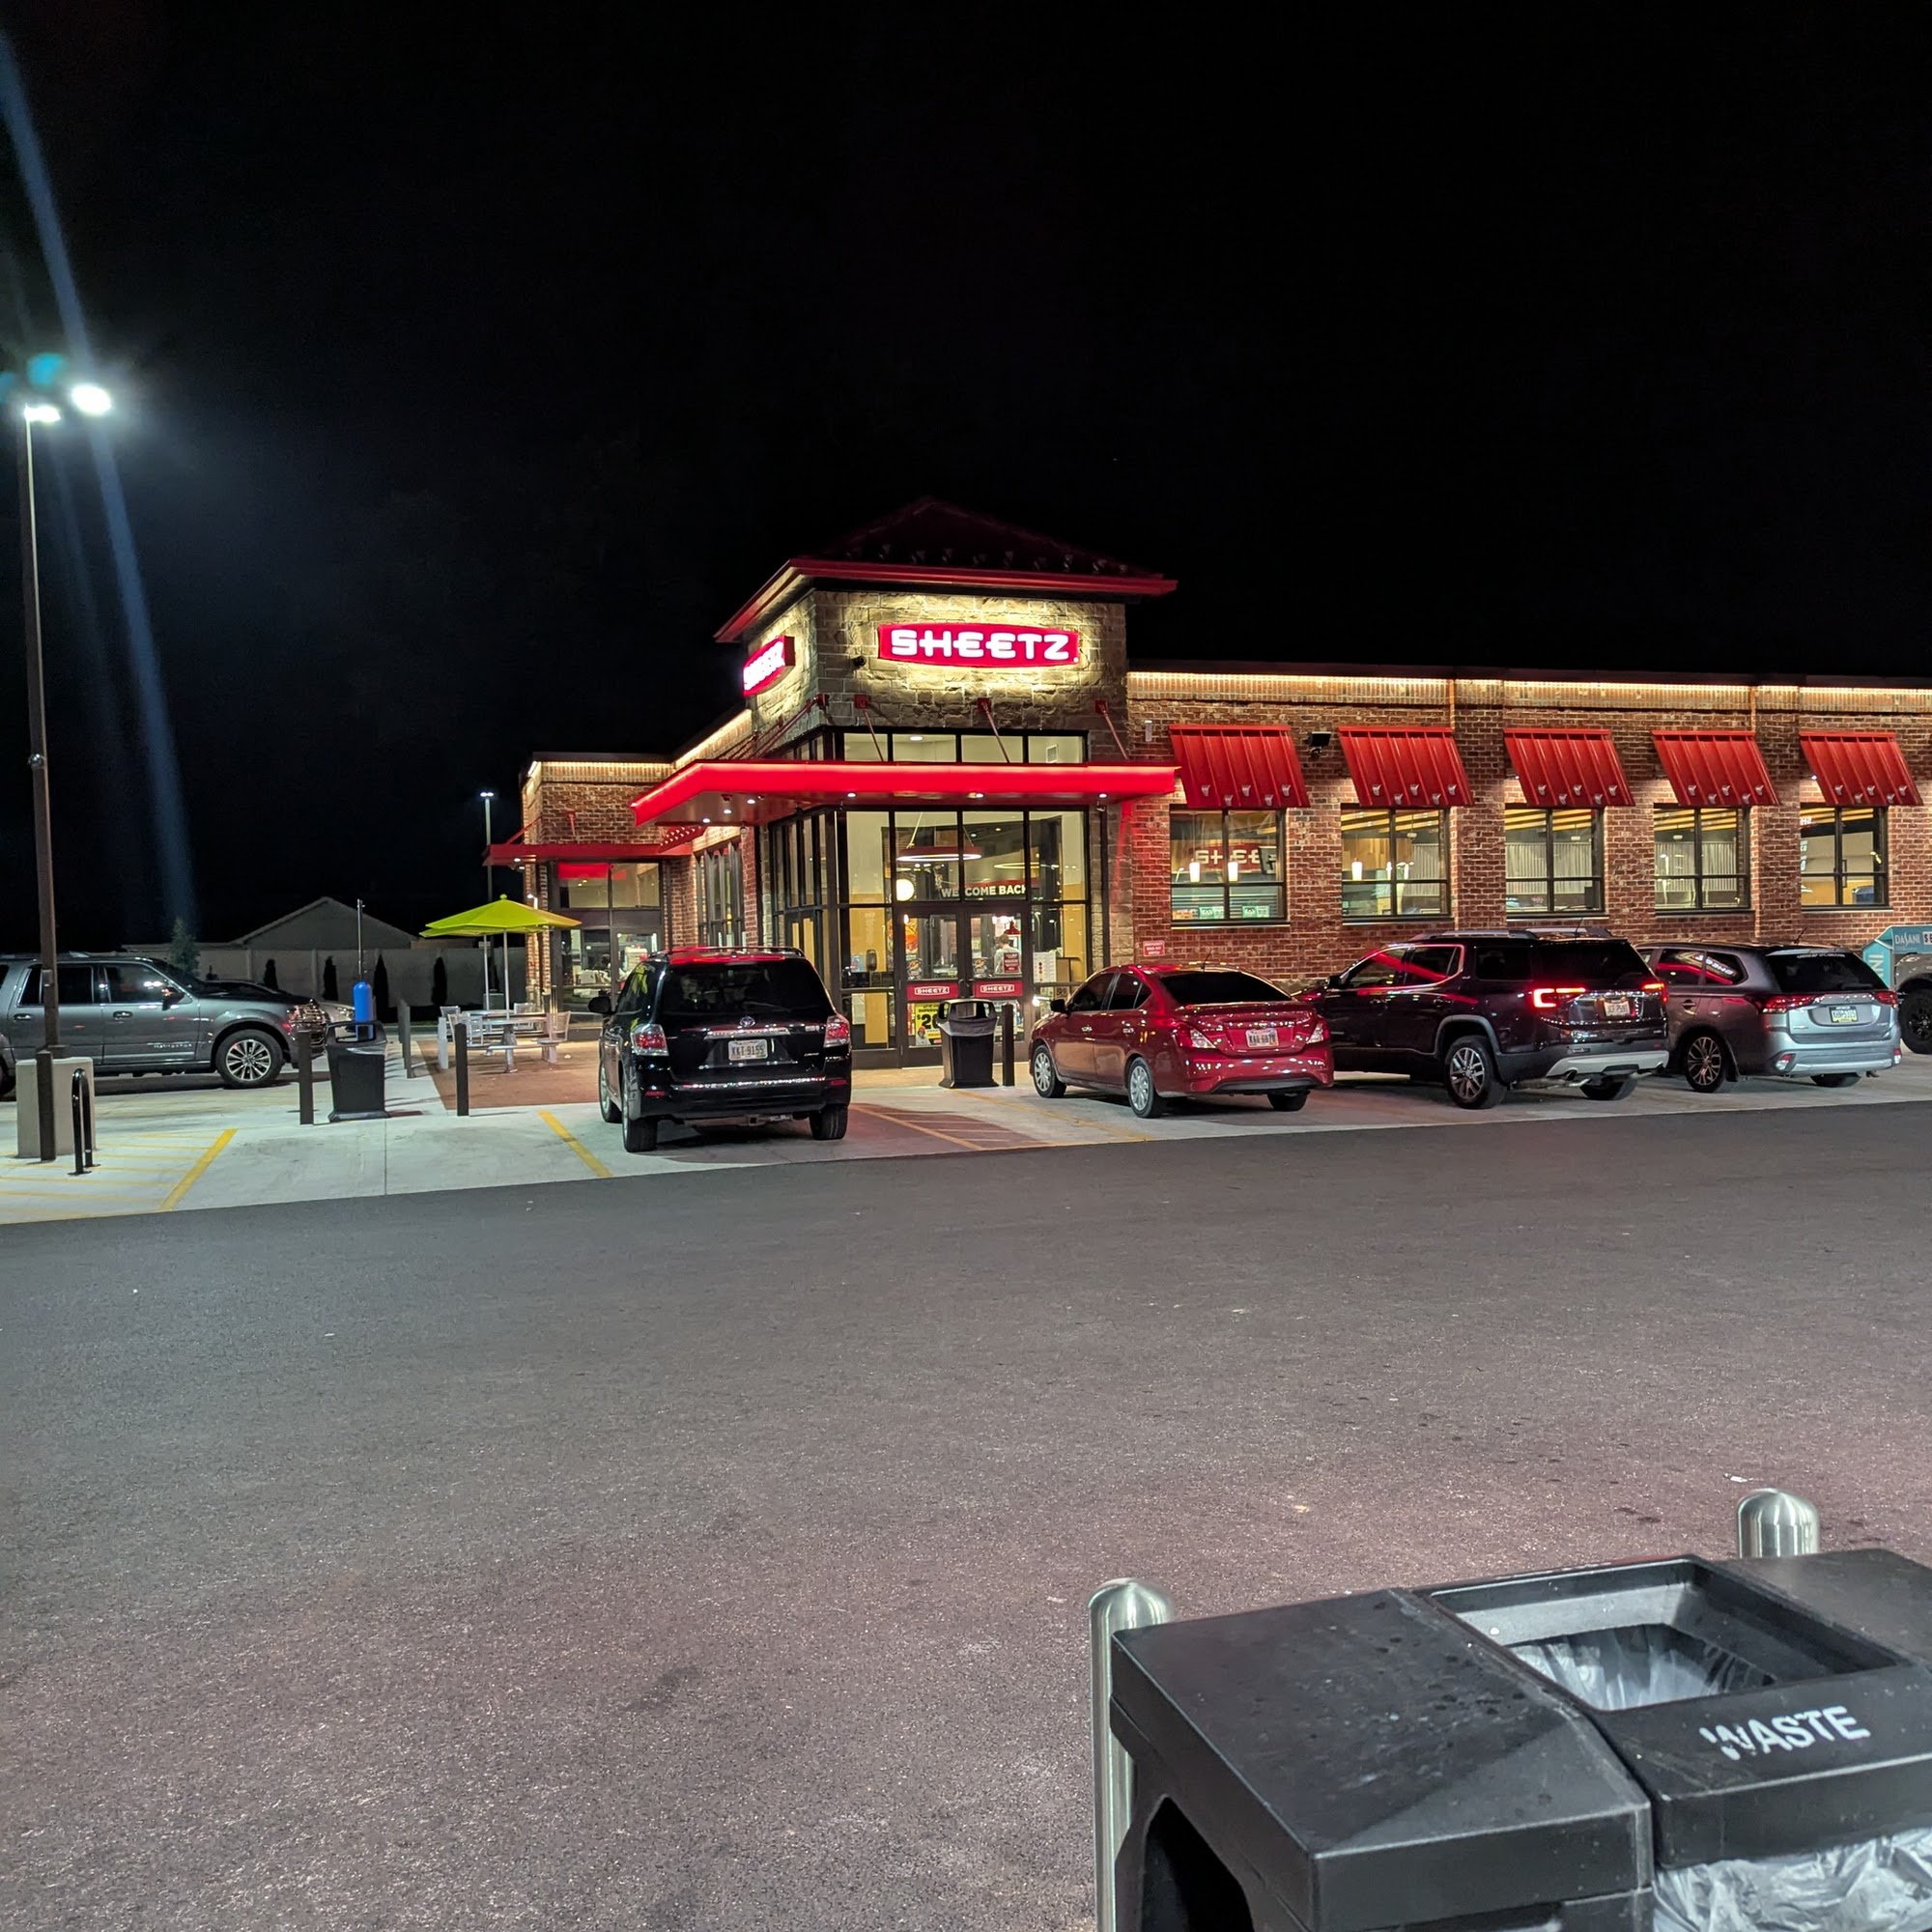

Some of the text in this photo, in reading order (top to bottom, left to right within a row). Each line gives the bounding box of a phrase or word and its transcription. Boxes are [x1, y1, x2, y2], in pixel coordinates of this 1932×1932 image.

[891, 629, 1069, 661] SHEETZ
[941, 886, 996, 897] WECOME
[1894, 932, 1920, 946] DASANI
[1699, 1706, 1871, 1760] WASTE
